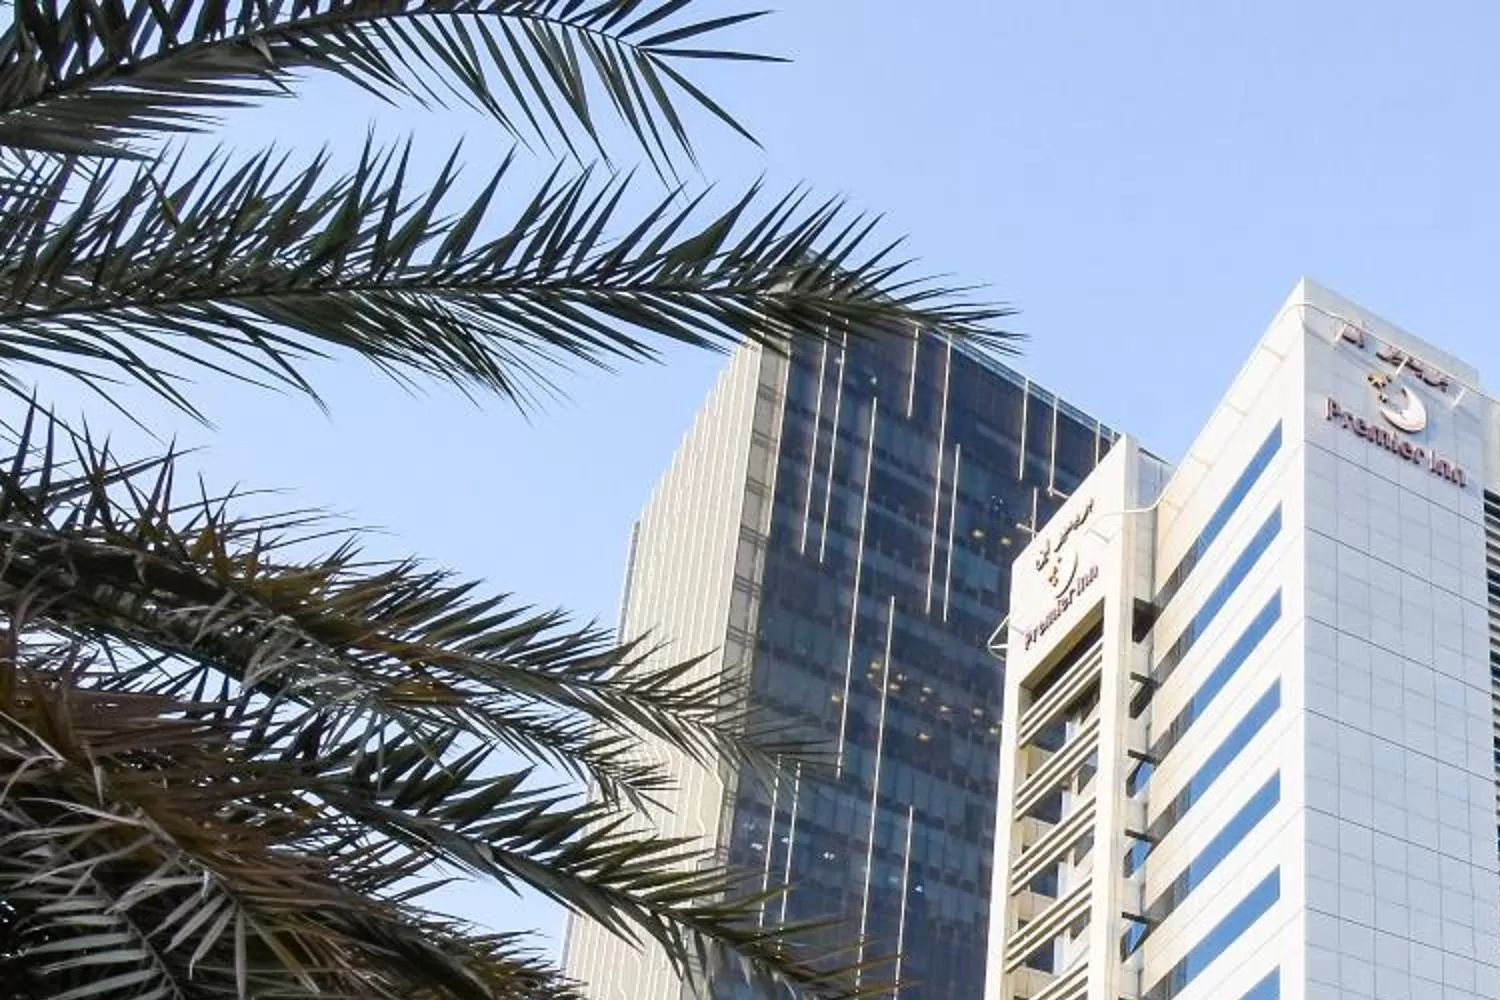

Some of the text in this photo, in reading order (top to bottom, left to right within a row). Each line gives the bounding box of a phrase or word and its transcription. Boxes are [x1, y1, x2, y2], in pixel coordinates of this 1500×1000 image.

[1325, 397, 1468, 488] Premier Inn
[1025, 565, 1099, 651] Premier Inn
